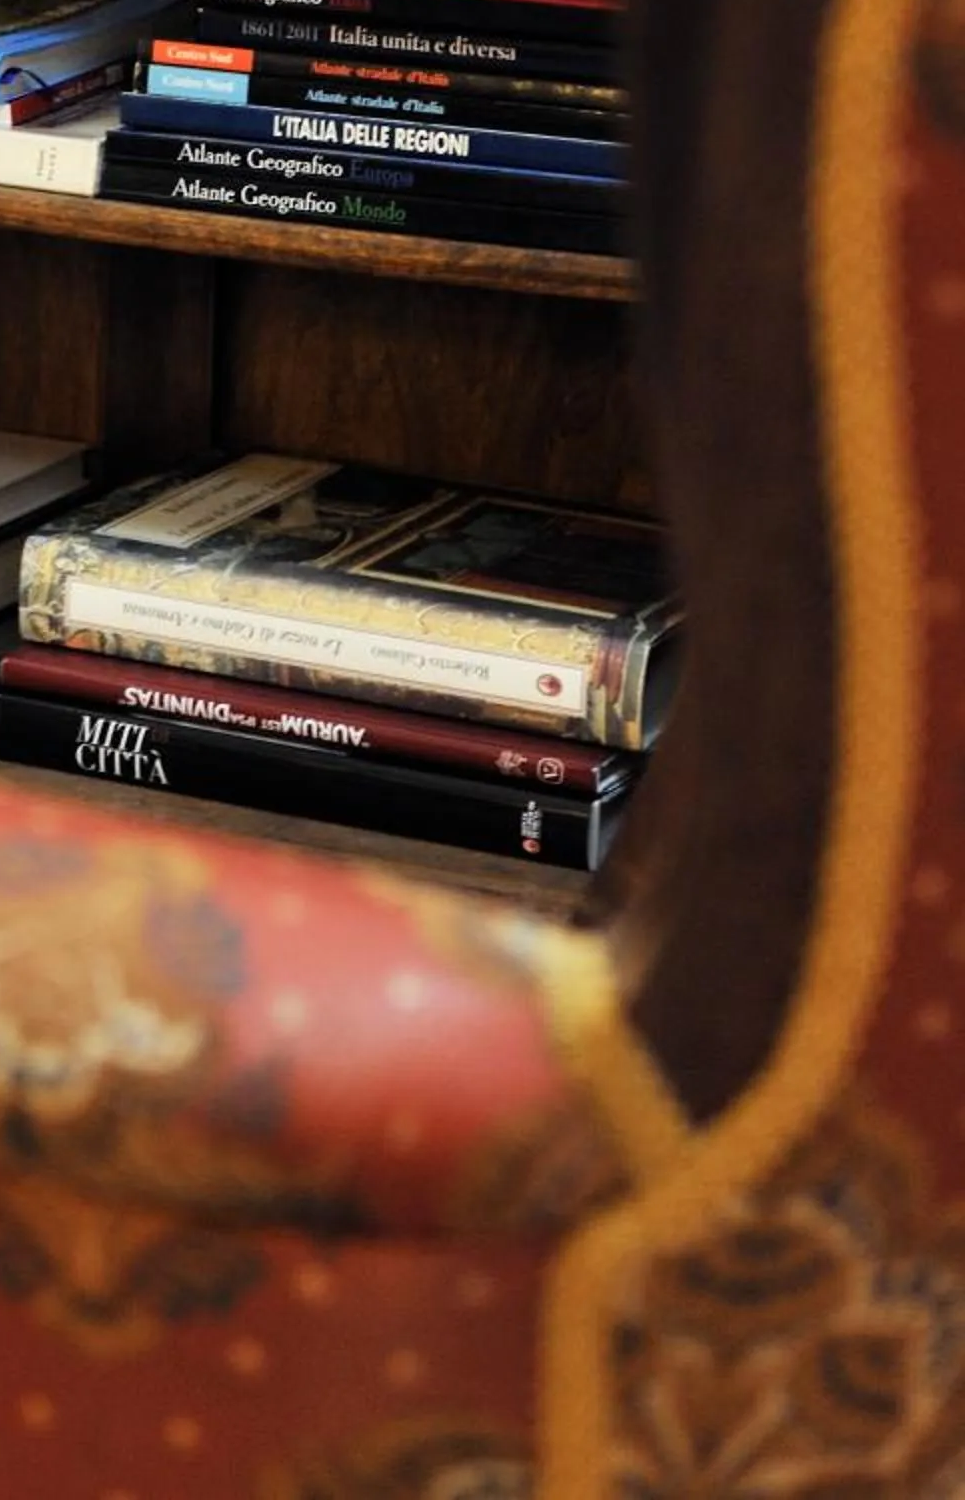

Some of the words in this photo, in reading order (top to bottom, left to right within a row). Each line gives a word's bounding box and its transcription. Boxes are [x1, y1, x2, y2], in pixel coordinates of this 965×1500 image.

[166, 45, 207, 62] Centro
[329, 23, 377, 48] Italia
[382, 30, 431, 54] unita
[434, 40, 446, 54] e
[449, 35, 517, 61] diversa
[162, 72, 204, 90] Centro
[310, 60, 352, 77] Atlante
[355, 64, 401, 83] stradale
[406, 67, 450, 87] d'Italia
[306, 88, 347, 106] Atlante
[350, 91, 399, 111] stradale
[402, 97, 445, 115] d'Italia
[272, 114, 339, 145] L'ITALIA
[342, 122, 390, 149] DELLE
[395, 128, 470, 157] REGIONI
[177, 142, 241, 168] Atlante
[246, 148, 344, 179] Geografico
[349, 158, 415, 188] Europa
[172, 176, 236, 203] Atlante
[240, 183, 337, 215] Geografico
[341, 194, 407, 222] Mondo
[203, 614, 256, 645] Cadmo
[261, 623, 276, 644] di
[75, 714, 150, 756] MITI
[74, 742, 170, 786] CITTÀ
